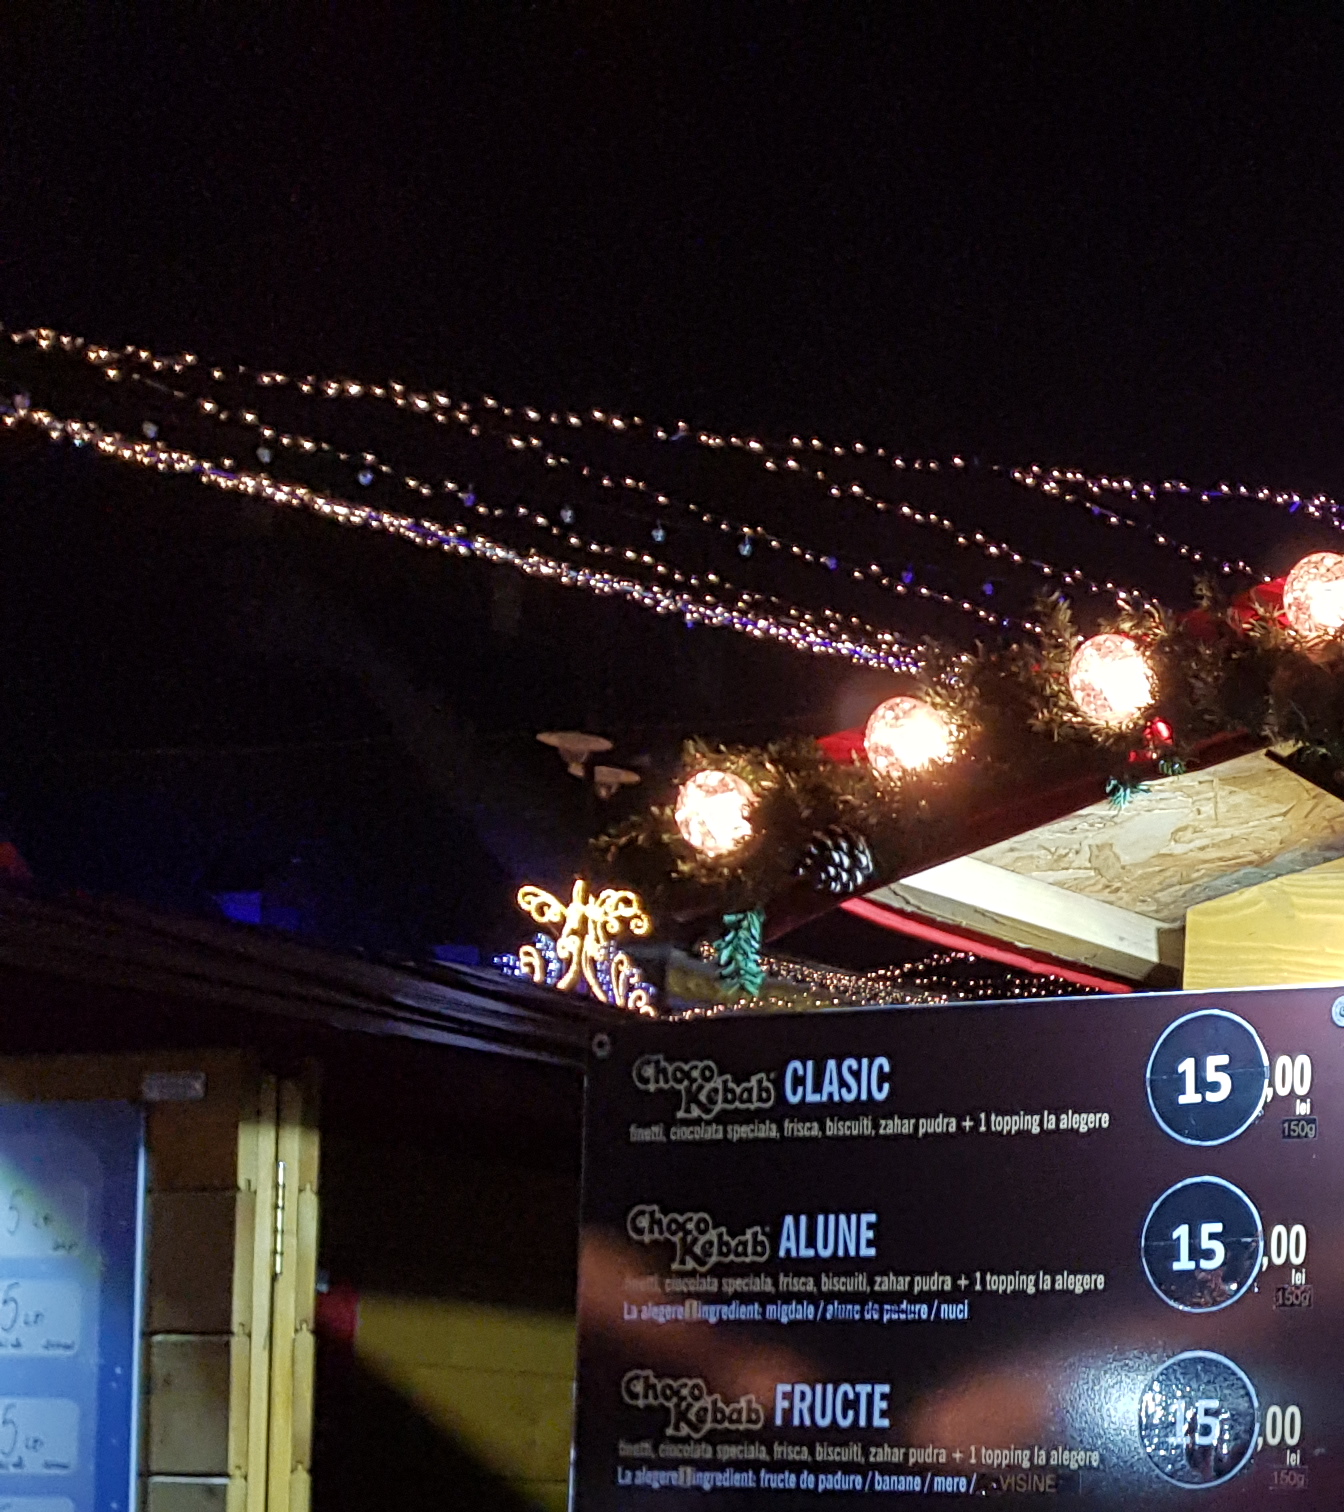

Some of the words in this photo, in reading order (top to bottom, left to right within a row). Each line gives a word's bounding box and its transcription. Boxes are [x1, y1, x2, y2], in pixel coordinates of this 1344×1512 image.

[633, 1054, 718, 1093] Choco
[784, 1056, 892, 1104] CLASIC
[1177, 1054, 1232, 1104] 15
[676, 1073, 775, 1119] Kebab
[1295, 1098, 1311, 1116] lei
[826, 1116, 875, 1137] biscuiti,
[878, 1114, 916, 1135] zahar
[919, 1113, 956, 1138] pudra
[979, 1112, 986, 1132] 1
[991, 1111, 1040, 1135] topping
[1044, 1110, 1056, 1130] la
[1060, 1109, 1109, 1133] alegere
[1283, 1120, 1316, 1138] 150g
[627, 1203, 712, 1244] Choco
[779, 1213, 878, 1259] ALUNE
[670, 1225, 770, 1272] Kebab
[1172, 1222, 1226, 1271] 15
[1262, 1224, 1307, 1272] ,00
[873, 1272, 911, 1292] zahar
[914, 1271, 951, 1295] pudra
[986, 1270, 1036, 1294] topping
[1039, 1270, 1051, 1290] la
[1054, 1270, 1105, 1294] alegere
[1291, 1268, 1305, 1285] lei
[622, 1369, 707, 1409] Choco
[774, 1383, 890, 1429] FRUCTE
[665, 1393, 765, 1439] Kebab
[1257, 1404, 1301, 1452] ,00
[869, 1443, 906, 1462] zahar
[908, 1444, 946, 1466] pudra
[981, 1445, 1030, 1469] topping
[1034, 1445, 1047, 1465] la
[1050, 1445, 1100, 1470] alegere
[1286, 1449, 1300, 1466] lei
